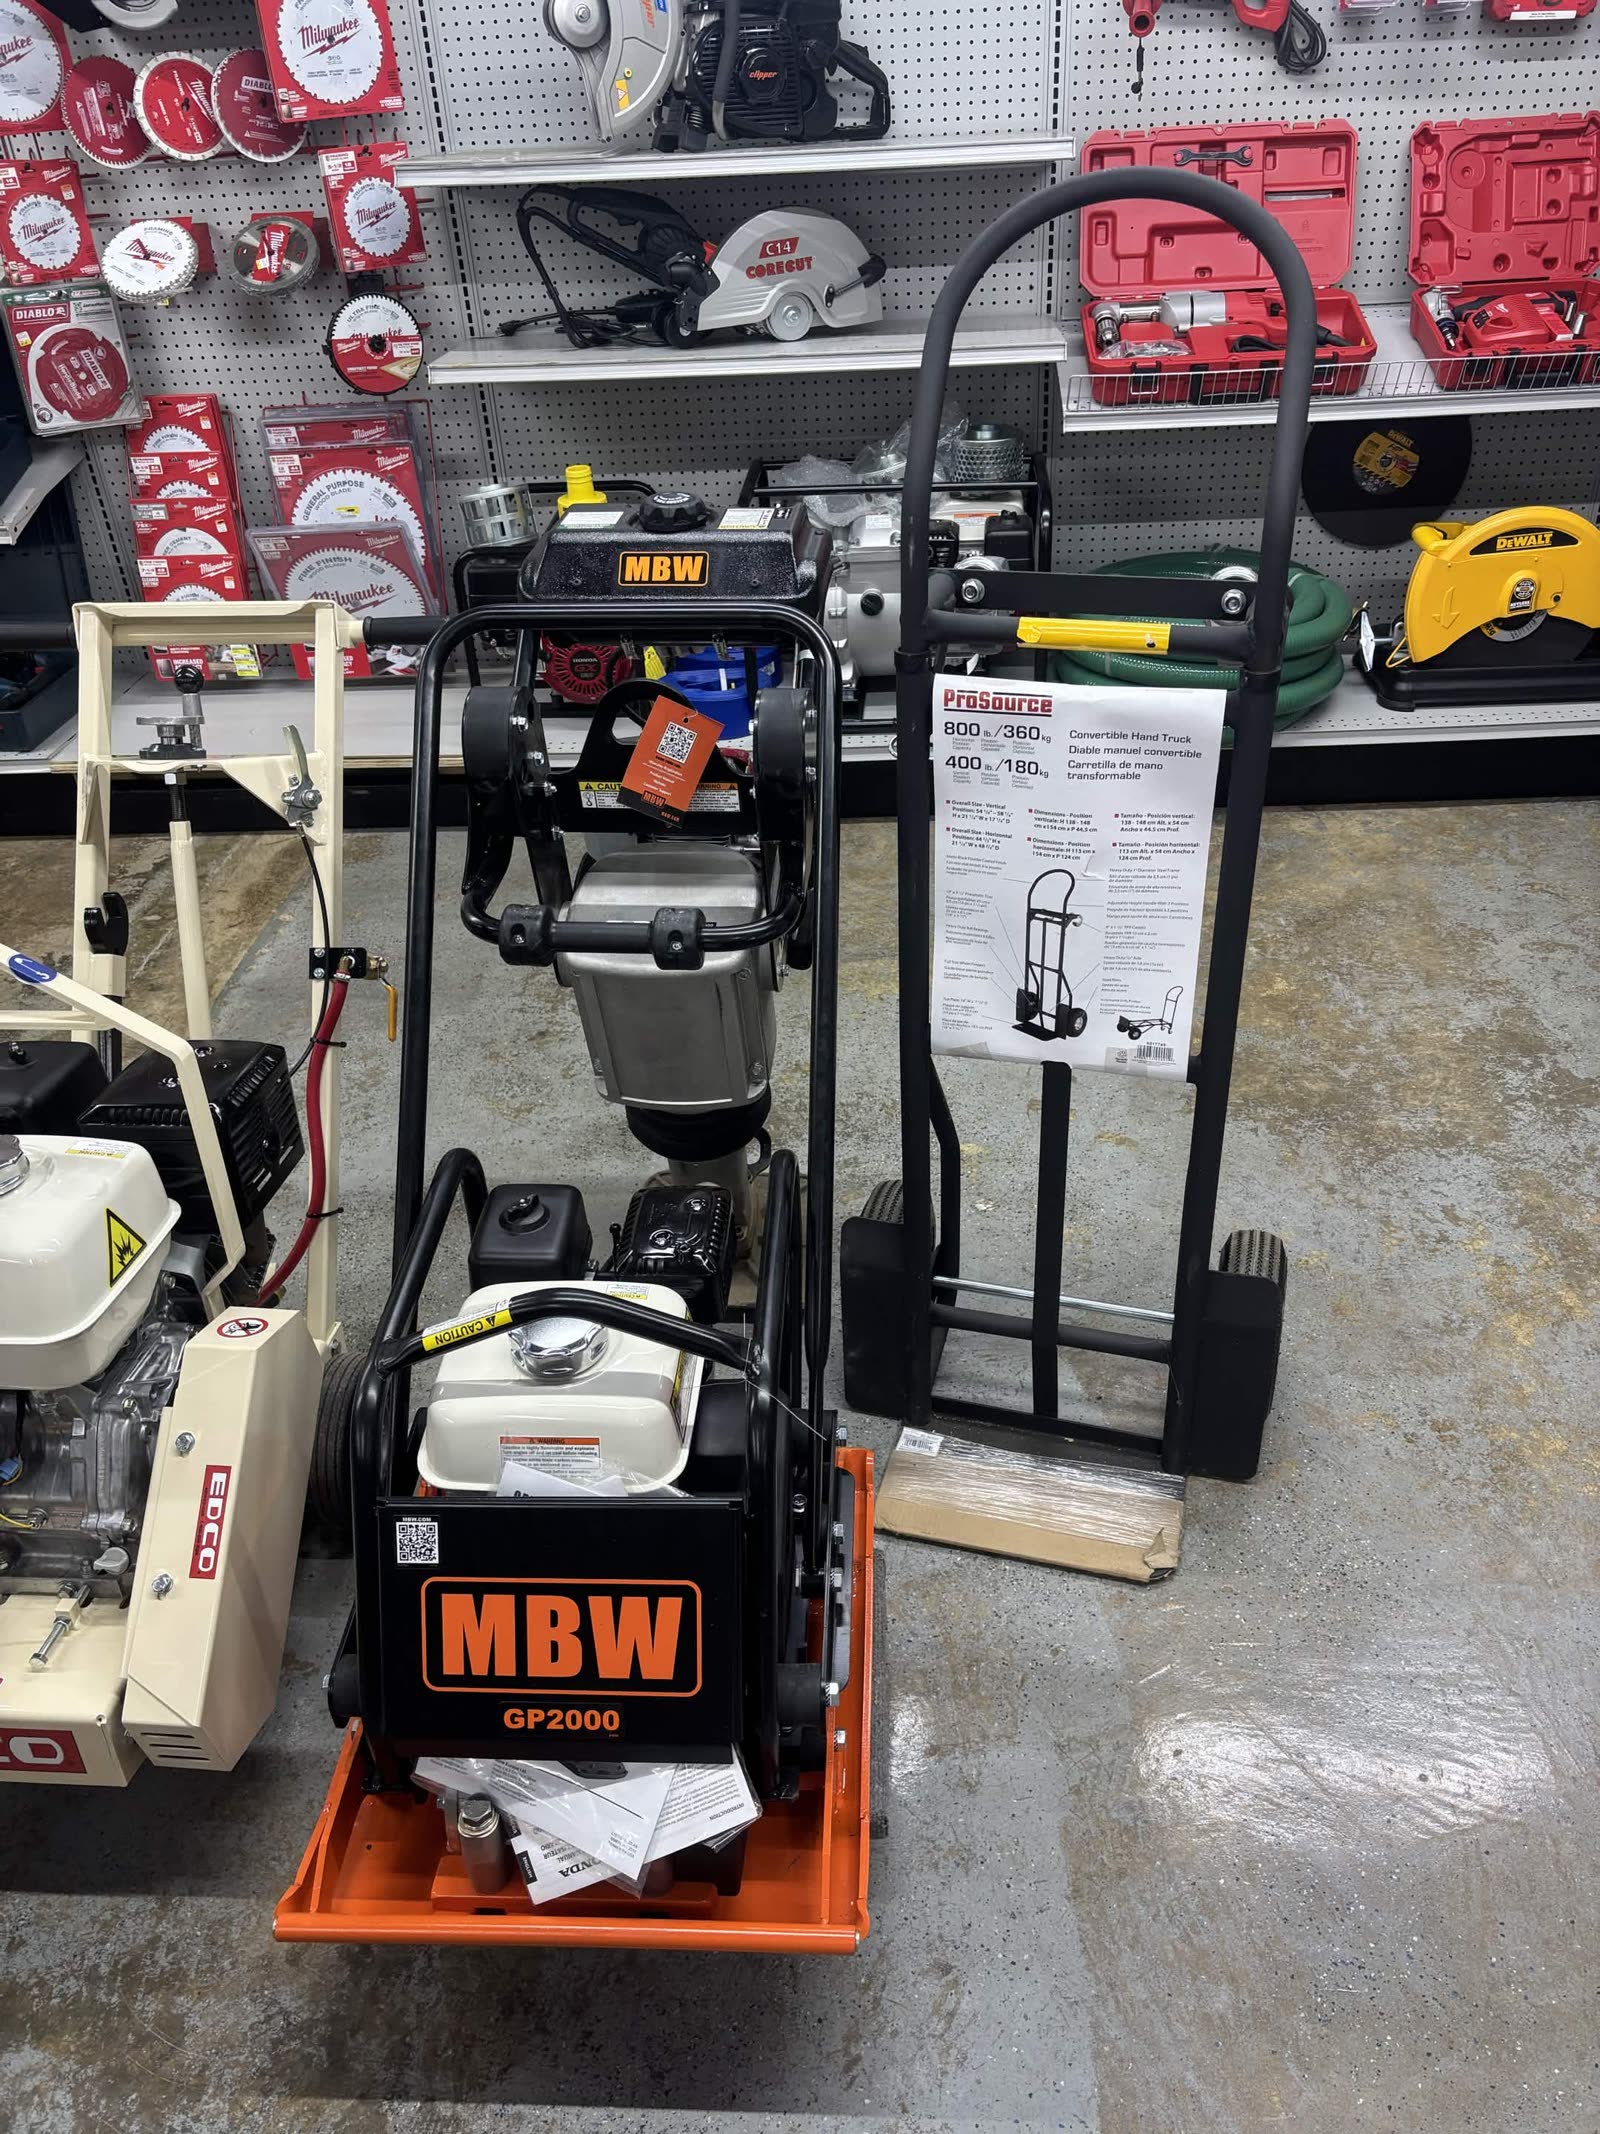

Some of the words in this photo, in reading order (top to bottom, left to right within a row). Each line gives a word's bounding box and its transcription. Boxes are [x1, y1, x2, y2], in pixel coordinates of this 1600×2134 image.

[297, 18, 360, 49] Milwaukee
[749, 70, 777, 80] clipper
[42, 166, 71, 180] Milwaukee
[354, 201, 397, 225] Milwaukee
[20, 217, 65, 239] Milwaukee
[270, 231, 284, 275] Milwaukee
[766, 241, 791, 256] C14
[746, 256, 813, 279] CORECUT
[16, 307, 54, 320] DIABLO
[347, 307, 365, 322] ULTRA
[82, 352, 105, 381] DIABLO
[176, 400, 207, 415] Milwaukee
[352, 425, 386, 440] Milwaukee
[186, 456, 217, 471] Milwaukee
[375, 452, 410, 468] Milwaukee
[303, 487, 326, 522] GENERAL
[325, 479, 365, 493] PURPOSE
[314, 495, 330, 511] WOOD
[331, 488, 352, 497] BLADE
[192, 503, 226, 518] Milwaukee
[366, 535, 400, 547] Milwaukee
[199, 560, 232, 575] Milwaukee
[298, 564, 316, 582] FINE
[316, 556, 353, 567] FINISH
[624, 556, 703, 582] MBW
[311, 583, 395, 607] Milwaukee
[173, 658, 204, 666] INCREASED
[943, 688, 1053, 713] ProSource
[944, 721, 981, 737] 800
[1069, 729, 1129, 740] Convertible
[1131, 731, 1159, 742] Hand
[1162, 733, 1192, 744] Truck
[1069, 745, 1101, 755] Diable
[1103, 746, 1142, 755] manuel
[1144, 748, 1203, 759] convertible
[945, 755, 982, 770] 400
[1067, 759, 1116, 769] Carretilla
[1118, 760, 1132, 769] de
[1134, 762, 1164, 770] mano
[1067, 771, 1141, 781] transformable
[643, 791, 665, 807] MBW
[1033, 809, 1066, 818] Dimensions
[1034, 816, 1059, 824] verticale:
[985, 831, 1013, 839] Horizontal
[1032, 837, 1064, 846] Dimensions
[1032, 844, 1065, 853] horizontale:
[434, 1320, 484, 1345] CAUTION
[197, 1471, 227, 1574] EDCO
[441, 1593, 683, 1680] MBW
[503, 1708, 621, 1732] GP2000
[709, 1803, 745, 1821] INTRODUCTION
[558, 1858, 602, 1879] ONDA
